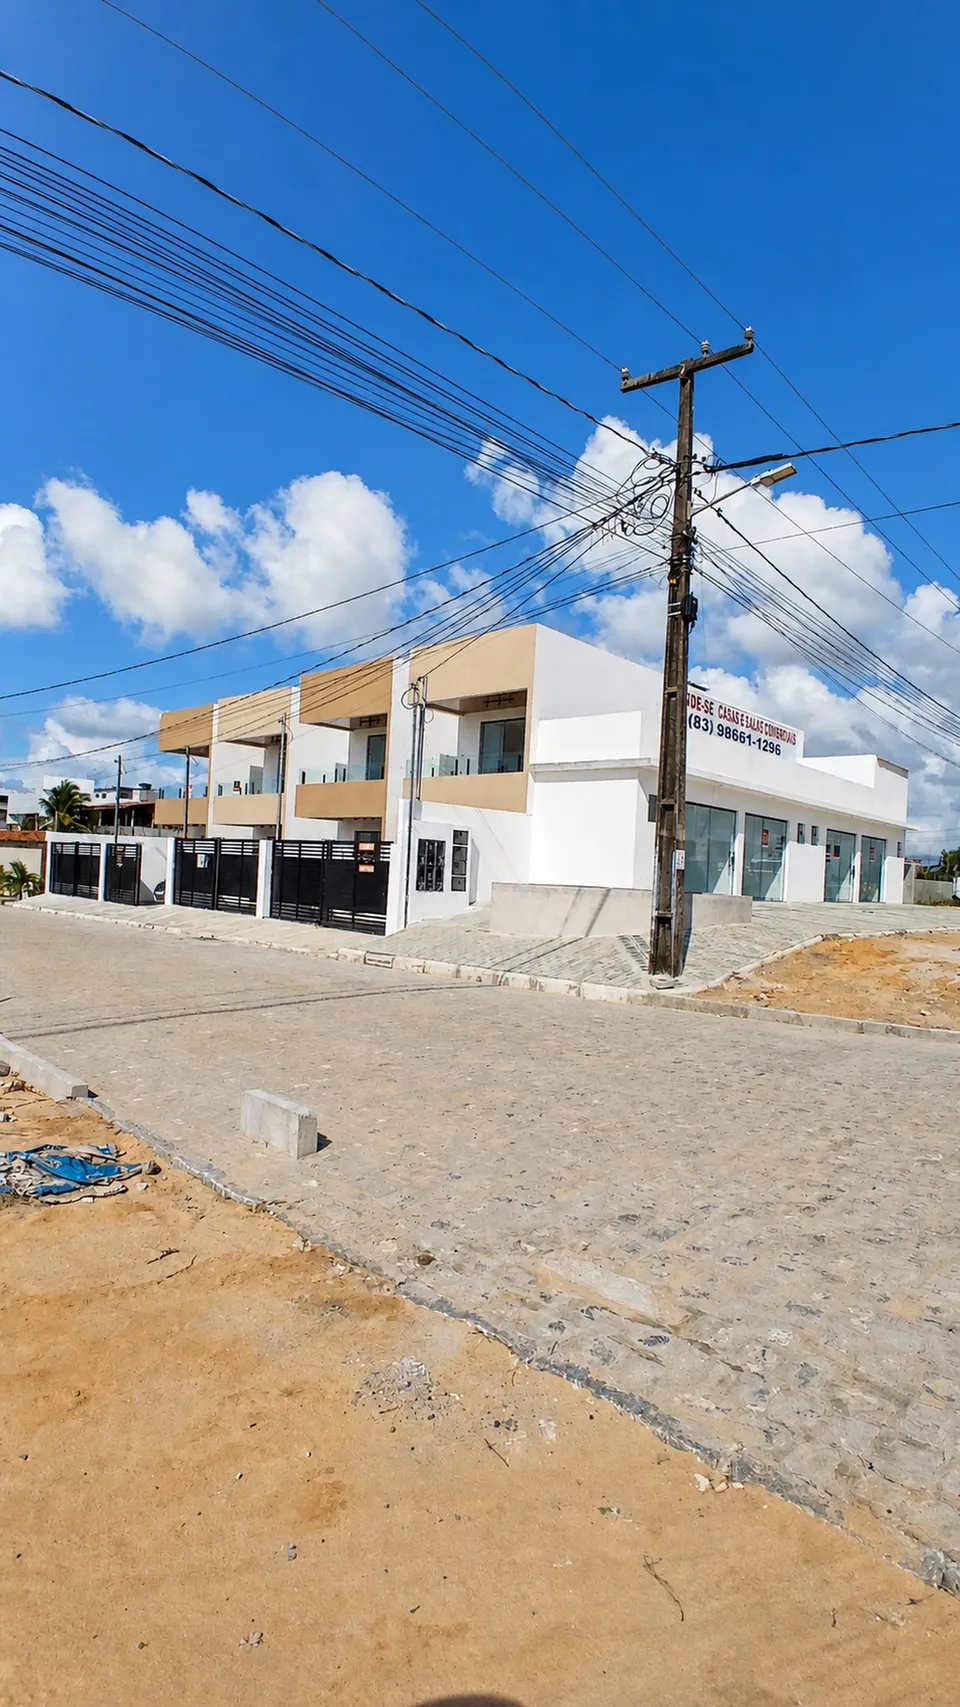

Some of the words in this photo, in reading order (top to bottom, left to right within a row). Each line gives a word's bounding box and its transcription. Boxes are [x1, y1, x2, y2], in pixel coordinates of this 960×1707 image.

[688, 713, 714, 735] (83)
[717, 723, 782, 756] 98661-1296
[718, 705, 739, 725] CASAS
[740, 713, 745, 727] E
[745, 715, 764, 734] SALAS
